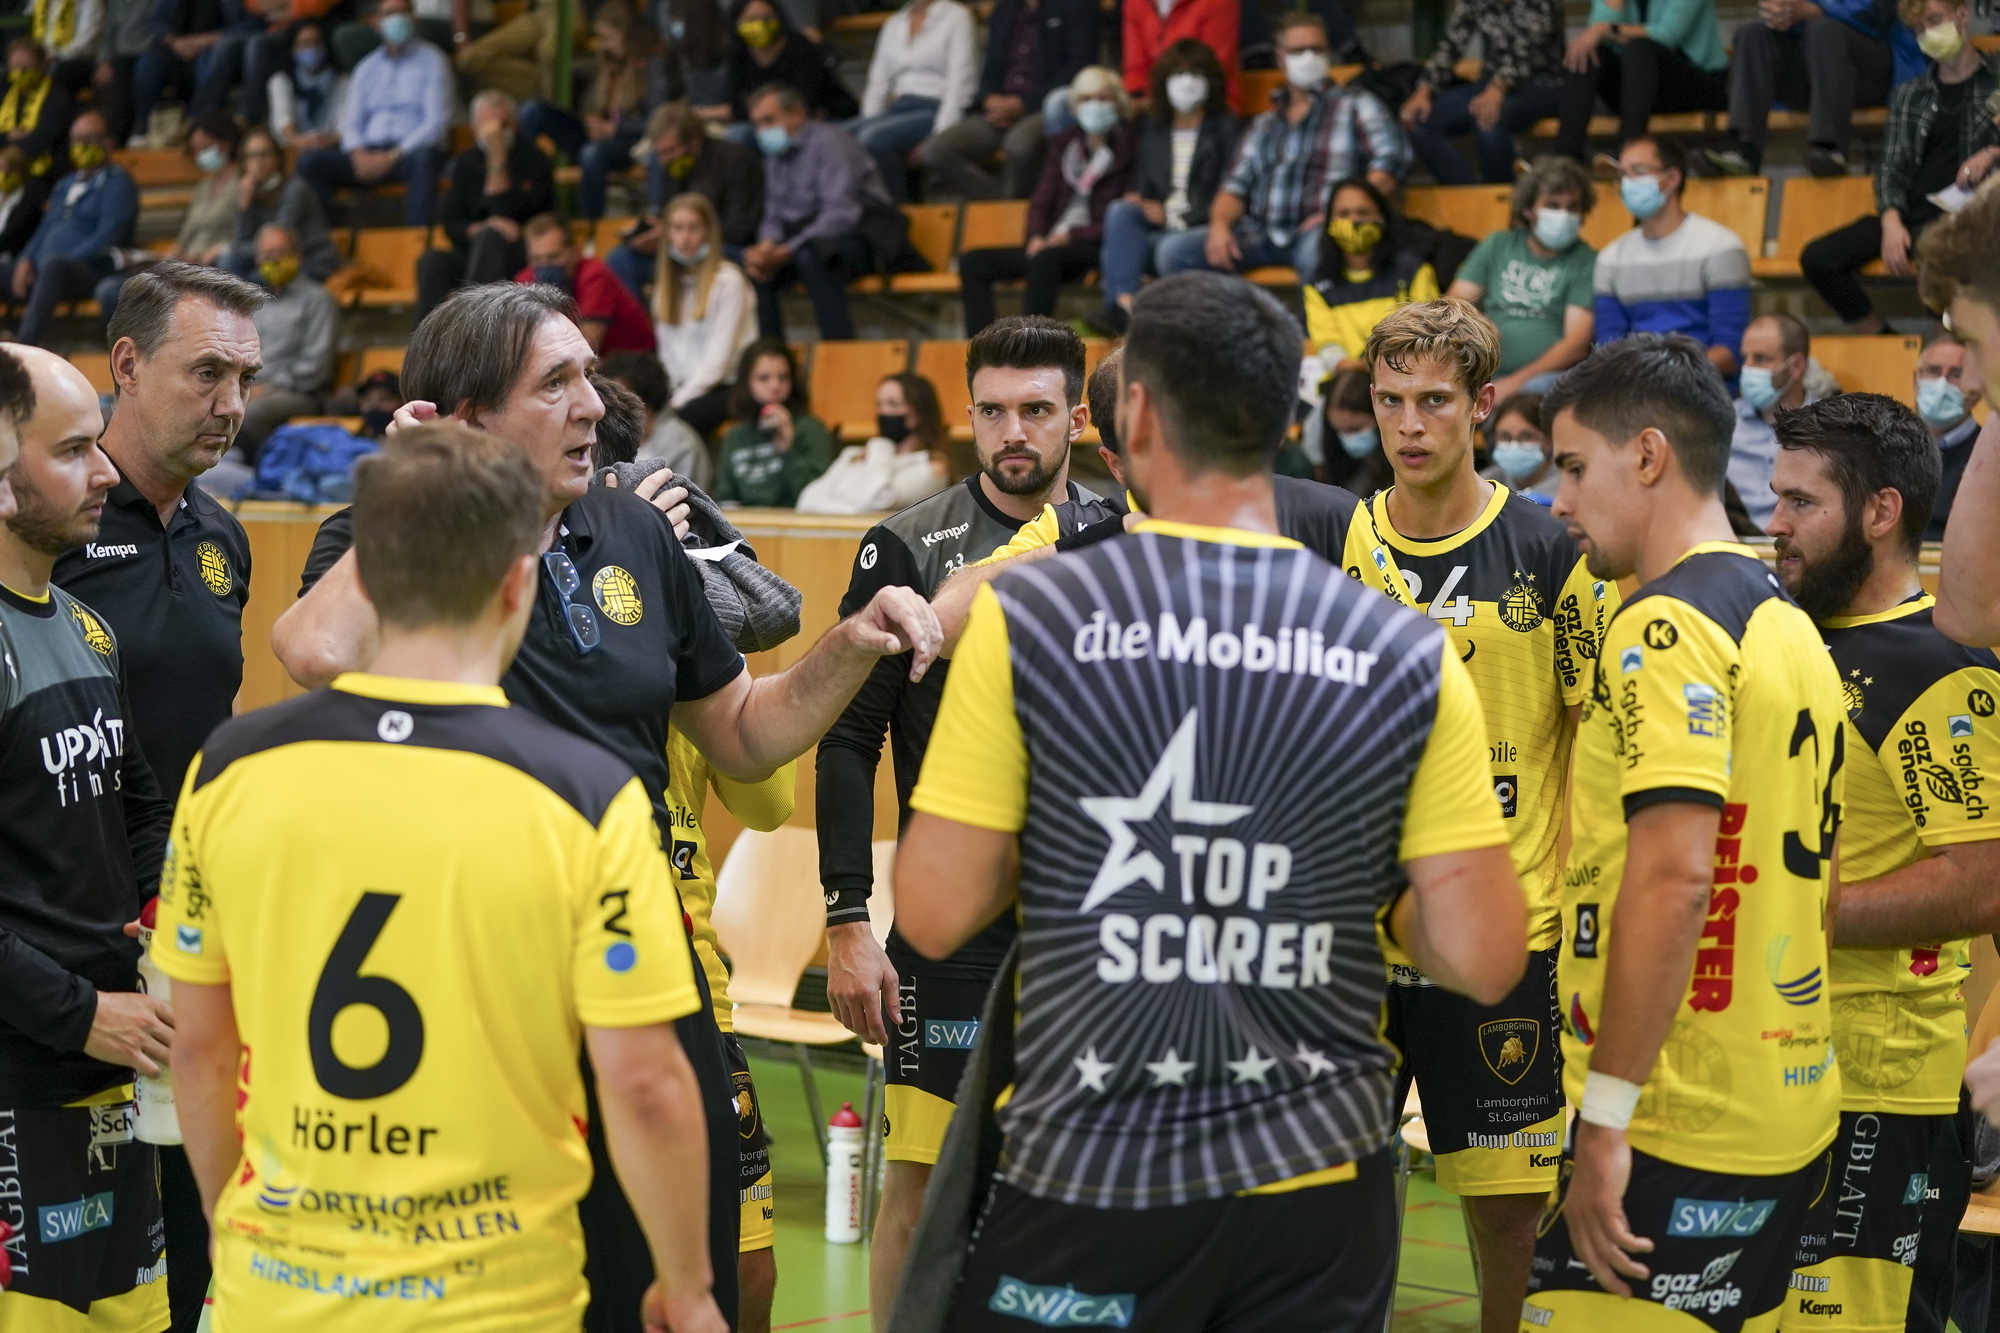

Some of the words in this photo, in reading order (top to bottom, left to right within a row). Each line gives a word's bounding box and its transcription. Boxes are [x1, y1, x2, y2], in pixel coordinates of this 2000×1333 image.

[86, 542, 138, 559] Kempa
[921, 521, 970, 548] Kempa
[1561, 593, 1582, 634] gaz
[1554, 613, 1581, 687] energie
[1905, 720, 1933, 765] gaz
[1898, 738, 1930, 828] energie
[1951, 743, 1989, 820] sgkb.ch
[1171, 834, 1293, 912] TOP
[1097, 912, 1335, 989] SCORER
[308, 890, 426, 1101] 6
[1483, 1021, 1536, 1036] LAMBORGHINI
[1476, 1093, 1549, 1109] Lamborghini
[1488, 1111, 1540, 1123] St.Gallen
[291, 1105, 439, 1157] Hörler
[1467, 1131, 1509, 1149] Hopp
[1512, 1130, 1558, 1147] Otmar
[249, 1252, 446, 1300] HIRSLANDEN
[1651, 1273, 1700, 1299] gaz
[1664, 1281, 1742, 1315] energie
[1799, 1298, 1843, 1319] Kempa
